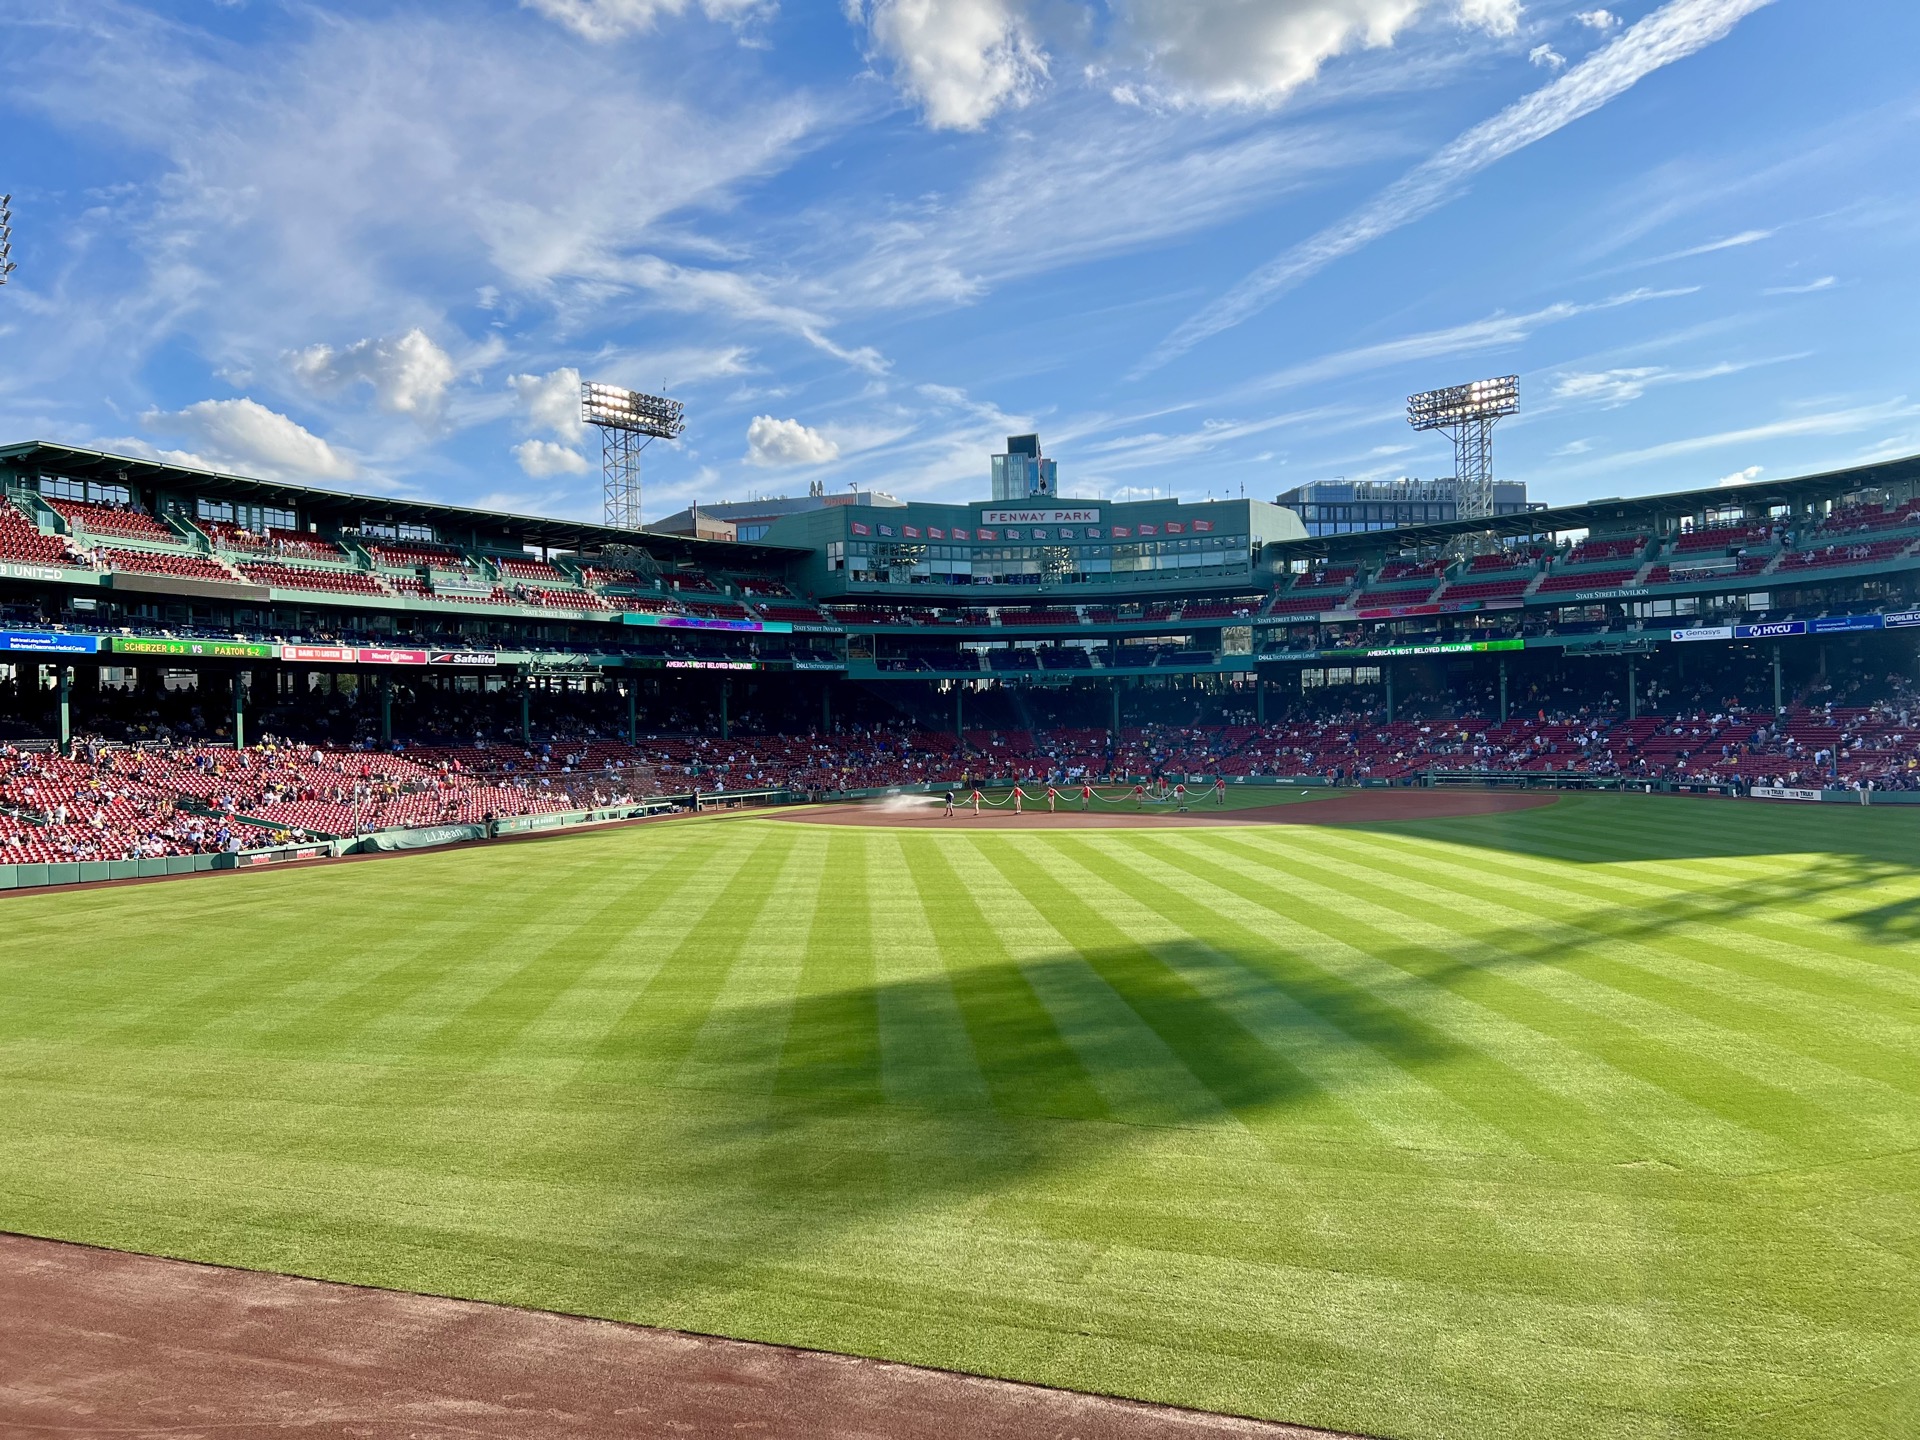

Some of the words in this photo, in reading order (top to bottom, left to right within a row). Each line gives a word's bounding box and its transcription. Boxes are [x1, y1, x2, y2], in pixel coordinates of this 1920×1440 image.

[990, 512, 1046, 522] FENWAY
[1054, 511, 1092, 521] PARK
[1575, 592, 1594, 600] STATE
[1618, 589, 1649, 597] PAVILION
[522, 608, 538, 616] STATE
[538, 609, 558, 617] STREET
[559, 611, 585, 619] PAVILION
[1886, 614, 1913, 622] COGHLIN
[1685, 629, 1721, 637] Genasys
[1763, 624, 1793, 634] HYCU
[124, 643, 167, 653] SCHERZER
[170, 645, 184, 653] 8-3
[191, 645, 203, 654] VS
[214, 646, 245, 656] PAXTON
[1367, 649, 1396, 657] AMERICA'S
[1441, 645, 1472, 653] BALLPARK
[453, 653, 495, 664] Safelite
[666, 661, 693, 669] AMERICA'S
[693, 661, 707, 669] MOST
[729, 662, 753, 670] BALLPARK
